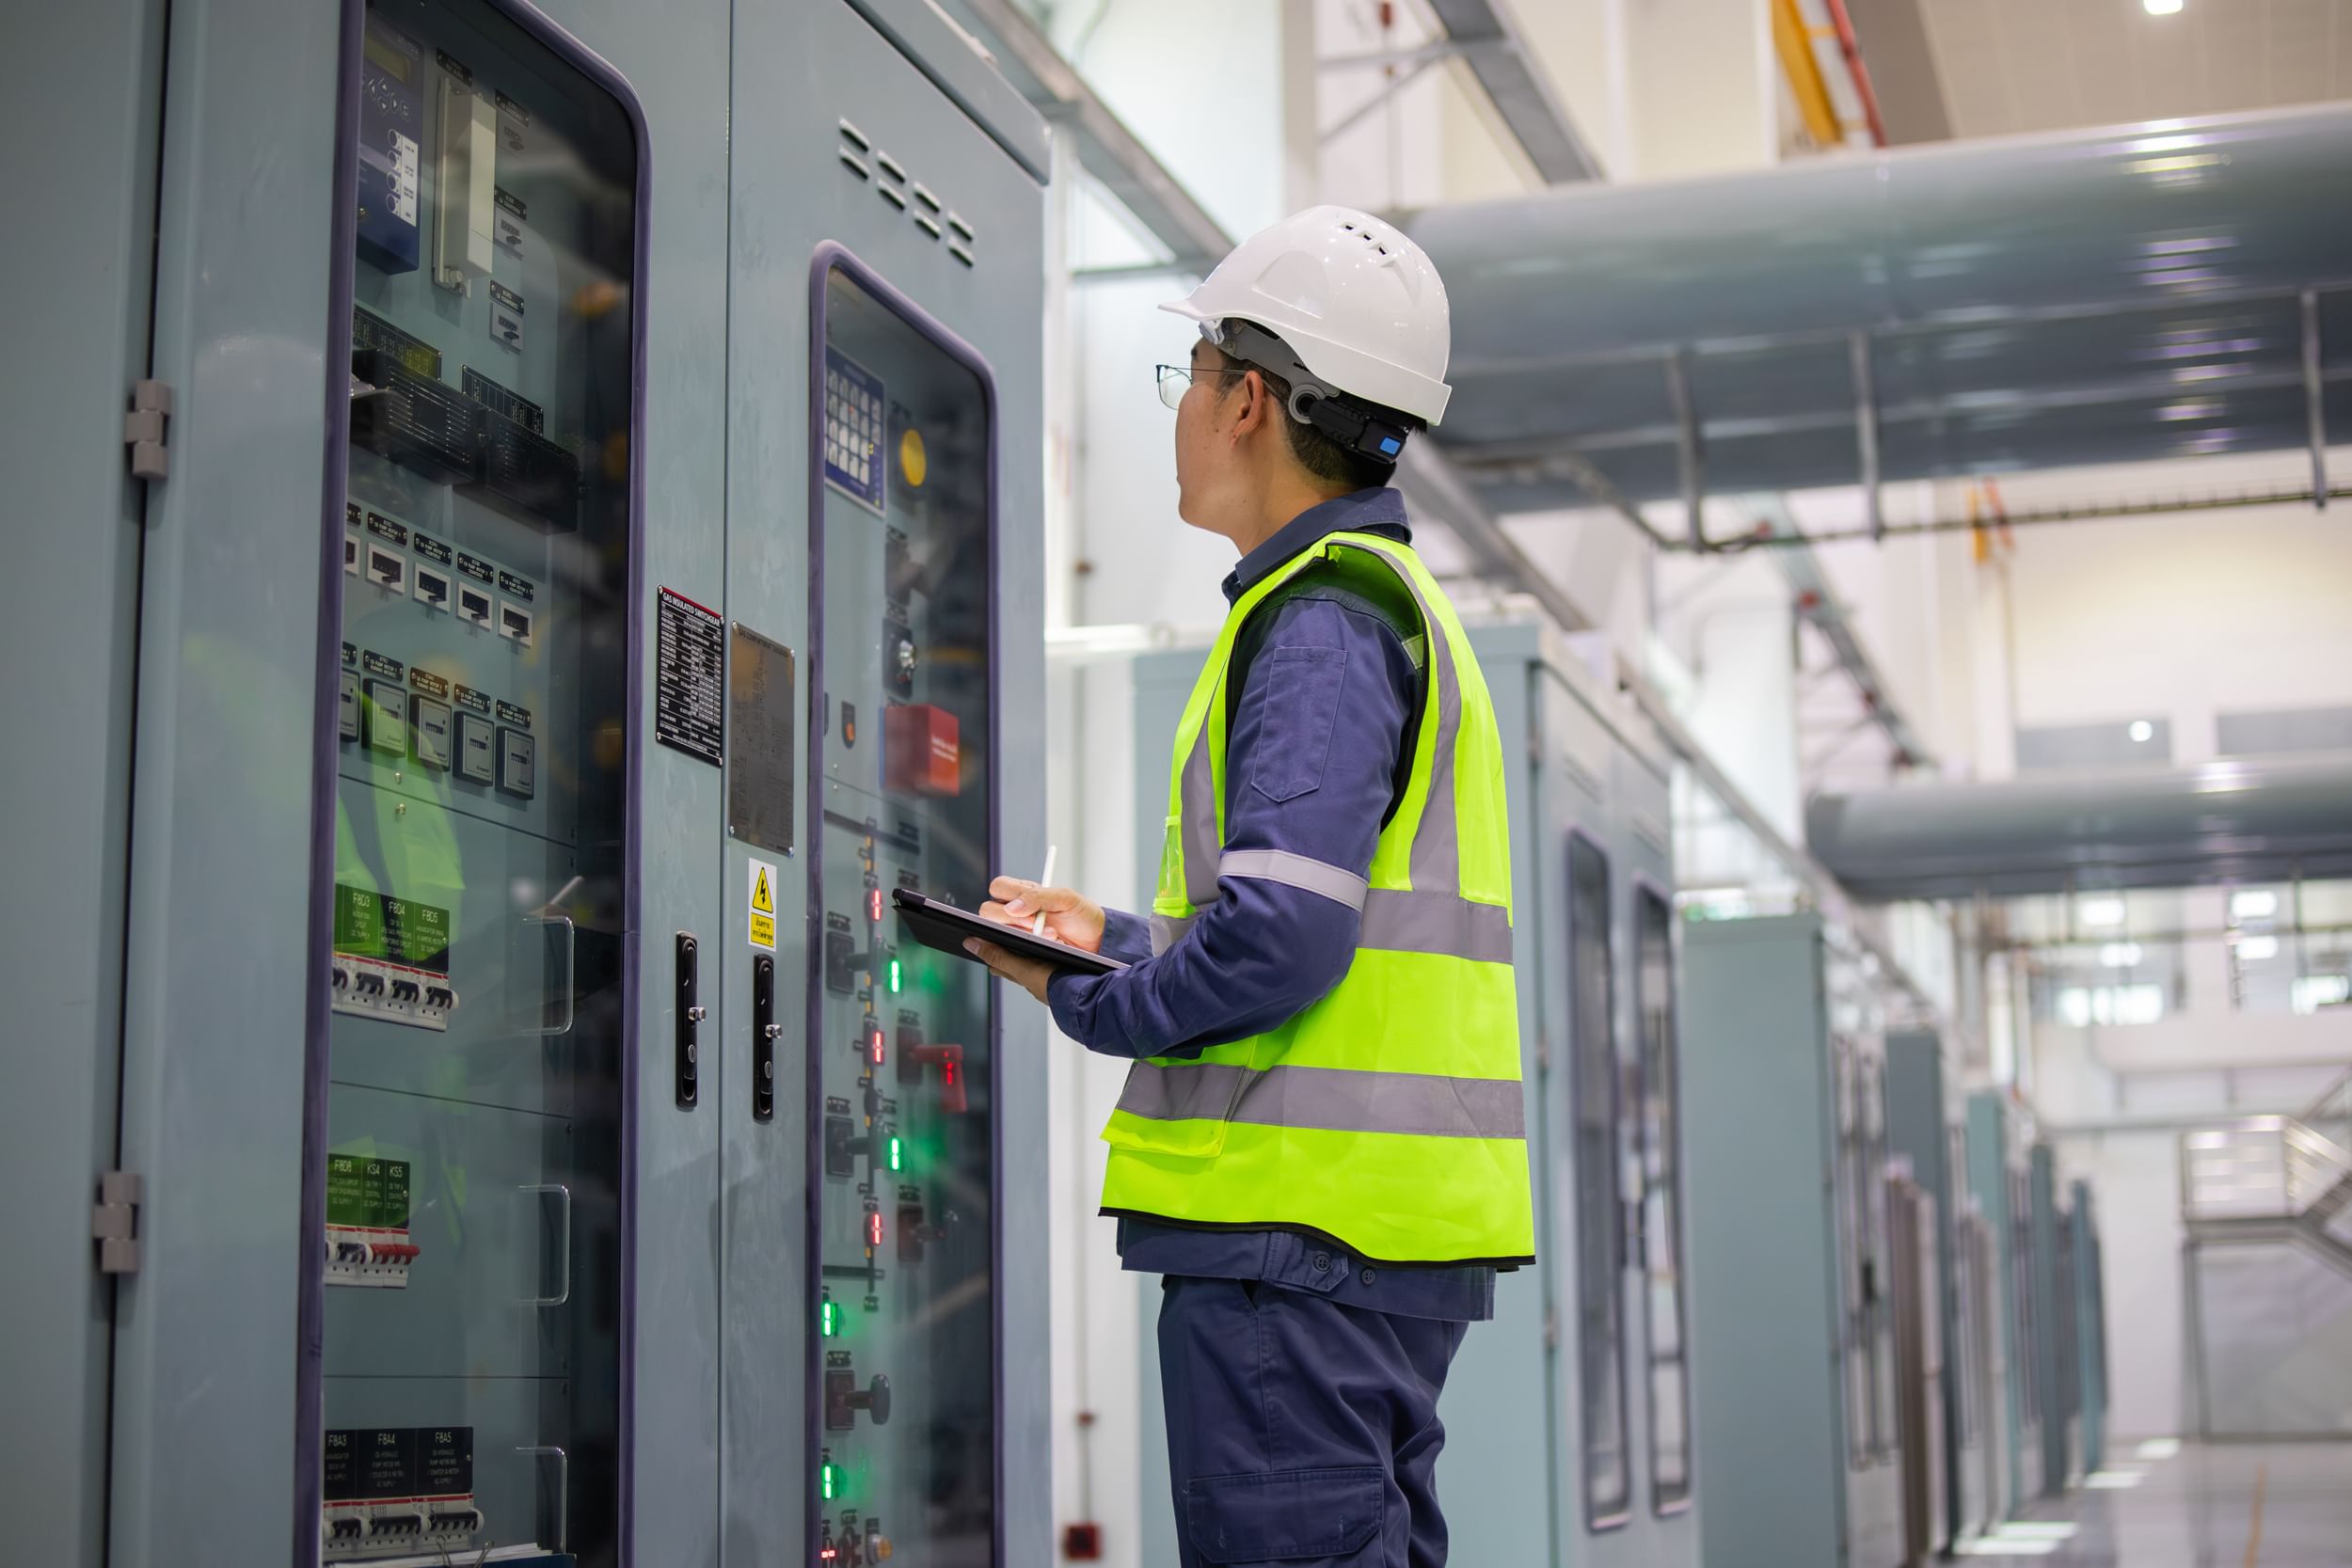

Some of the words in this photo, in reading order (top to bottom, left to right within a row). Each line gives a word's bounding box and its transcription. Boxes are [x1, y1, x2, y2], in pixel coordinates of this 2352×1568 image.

[662, 593, 673, 603] GAS
[672, 596, 695, 614] INSULATED
[694, 608, 721, 627] SWITCHGEAR
[367, 1163, 380, 1175] KS4
[389, 1165, 403, 1178] KS5
[377, 1433, 395, 1445] F8A4
[436, 1431, 452, 1444] F8A5
